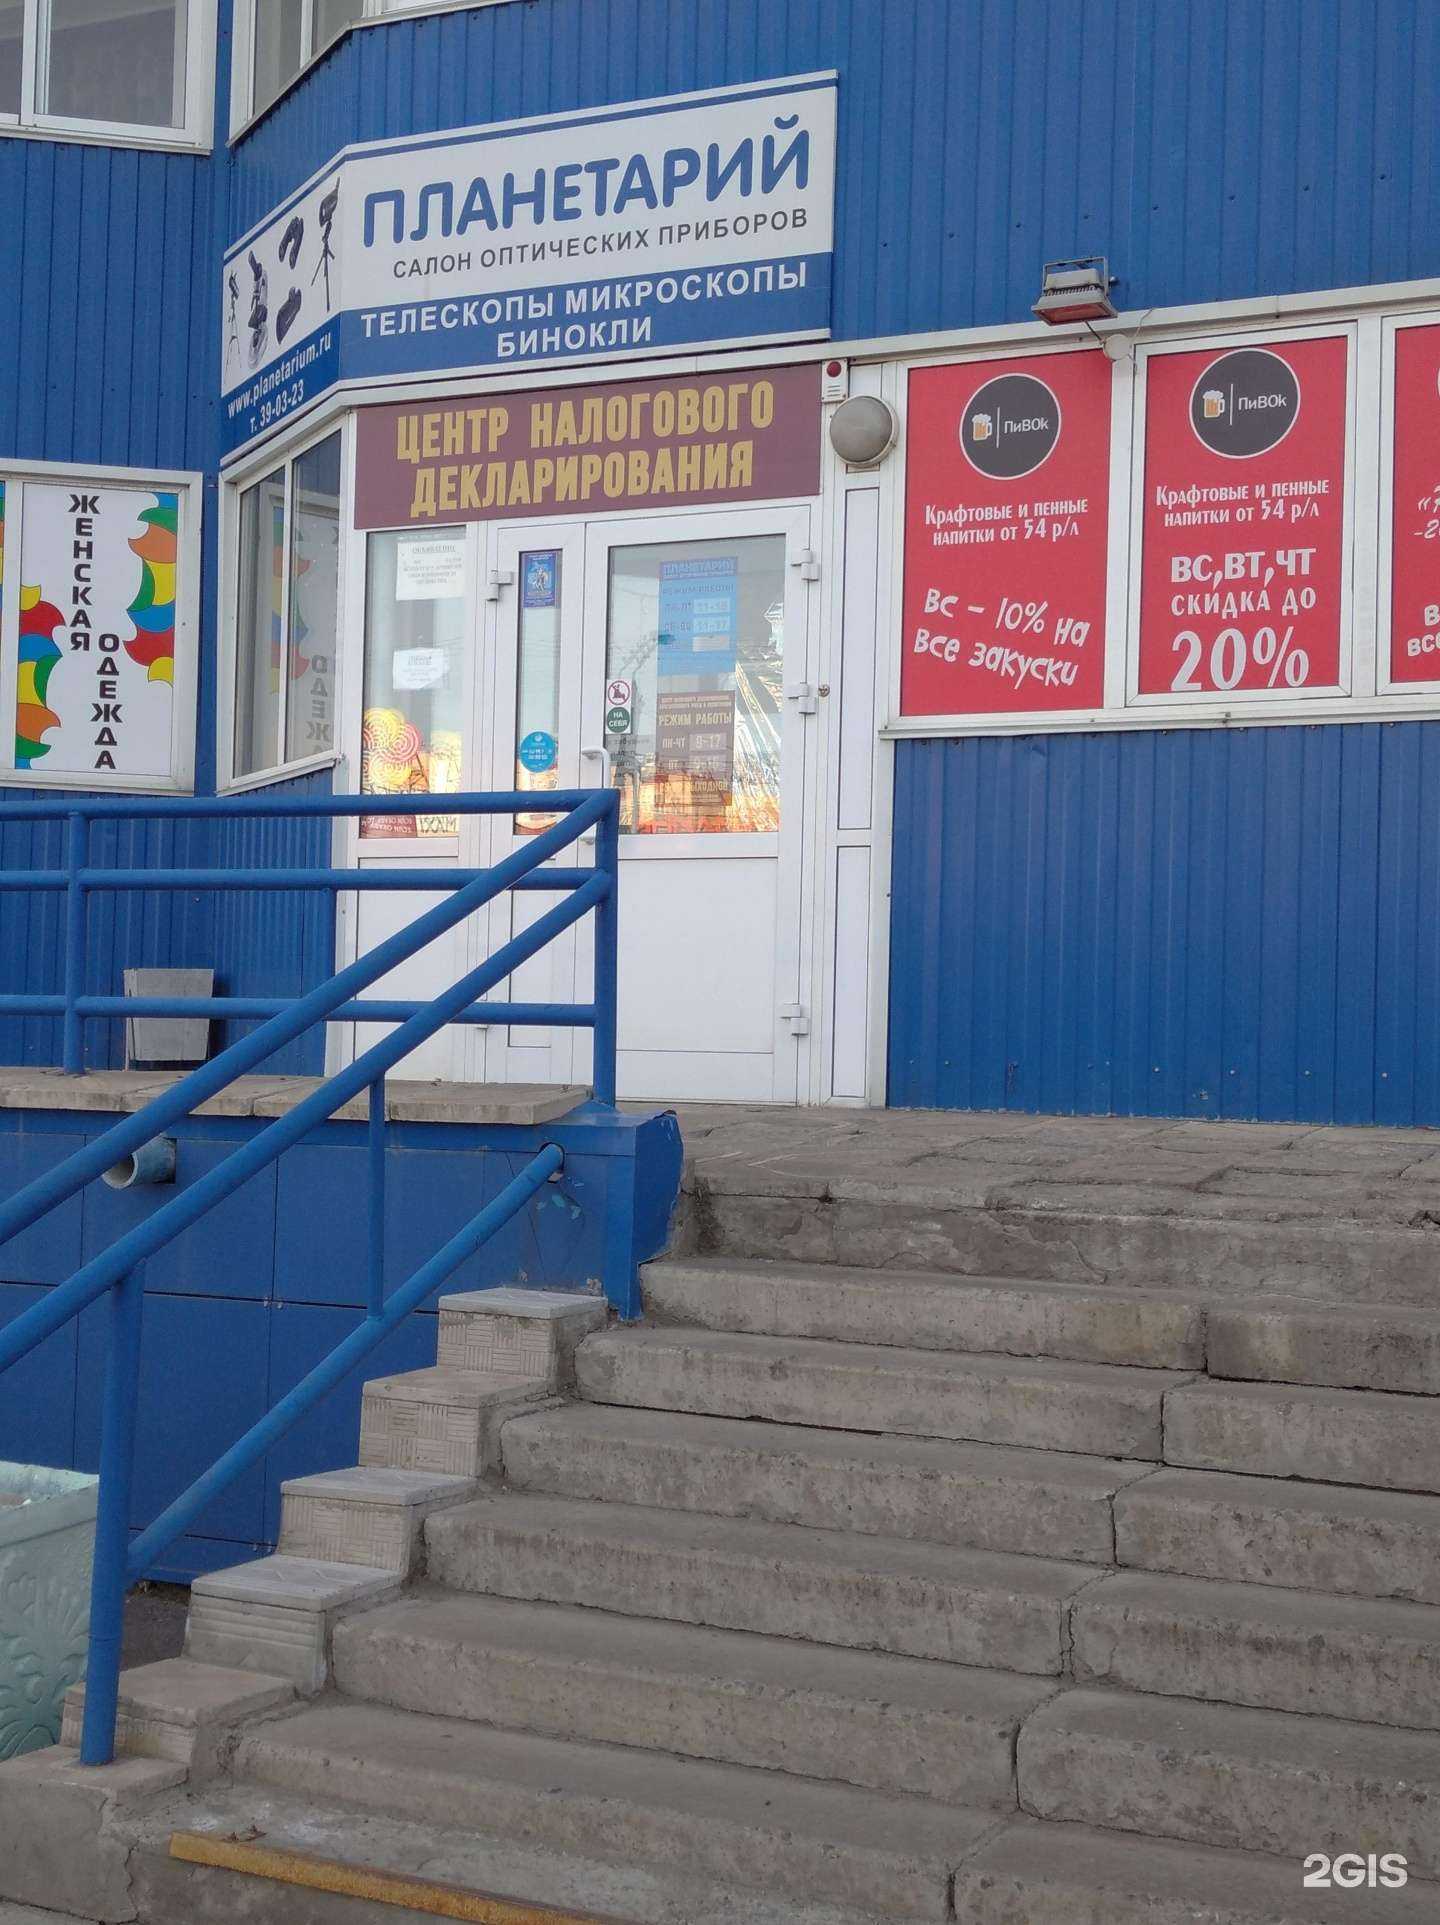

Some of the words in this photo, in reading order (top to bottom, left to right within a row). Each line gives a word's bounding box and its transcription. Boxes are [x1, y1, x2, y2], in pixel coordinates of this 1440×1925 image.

[363, 114, 810, 248] ПЛАНЕТАРИЙ
[393, 251, 472, 279] САЛОН
[481, 228, 649, 268] ОПТИЧЕСКИХ
[659, 207, 808, 246] ПРИБОРОВ
[361, 293, 553, 338] ТЕЛЕСКОПЫ
[565, 262, 807, 314] МИКРОСКОПЫ
[497, 316, 652, 358] БИНОКЛИ
[227, 332, 332, 419] www.planetarium.ru
[260, 379, 304, 427] 39-03-23
[397, 407, 509, 464] ЦЕНТР
[530, 380, 774, 449] НАЛОГОВОГО
[410, 439, 754, 518] ДЕКЛАРИРОВАНИЯ
[1156, 484, 1249, 510] Крафтовые
[925, 504, 1012, 529] Крафтовые
[1024, 517, 1046, 540] 54
[1052, 516, 1079, 542] р/л
[1261, 498, 1285, 521] 54
[1291, 497, 1320, 523] р/л
[68, 494, 100, 651] ЖЕНСКАЯ
[995, 597, 1048, 633] 10%
[1053, 617, 1090, 647] на
[968, 642, 1079, 690] закуски
[1170, 626, 1310, 691] 20%
[90, 633, 123, 770] ОДЕЖДА
[608, 720, 628, 728] СЕБЯ
[613, 711, 623, 719] НА
[658, 713, 692, 726] РЕЖИМ
[696, 711, 732, 726] РАБОТЫ
[662, 737, 686, 749] ПН-ЧТ
